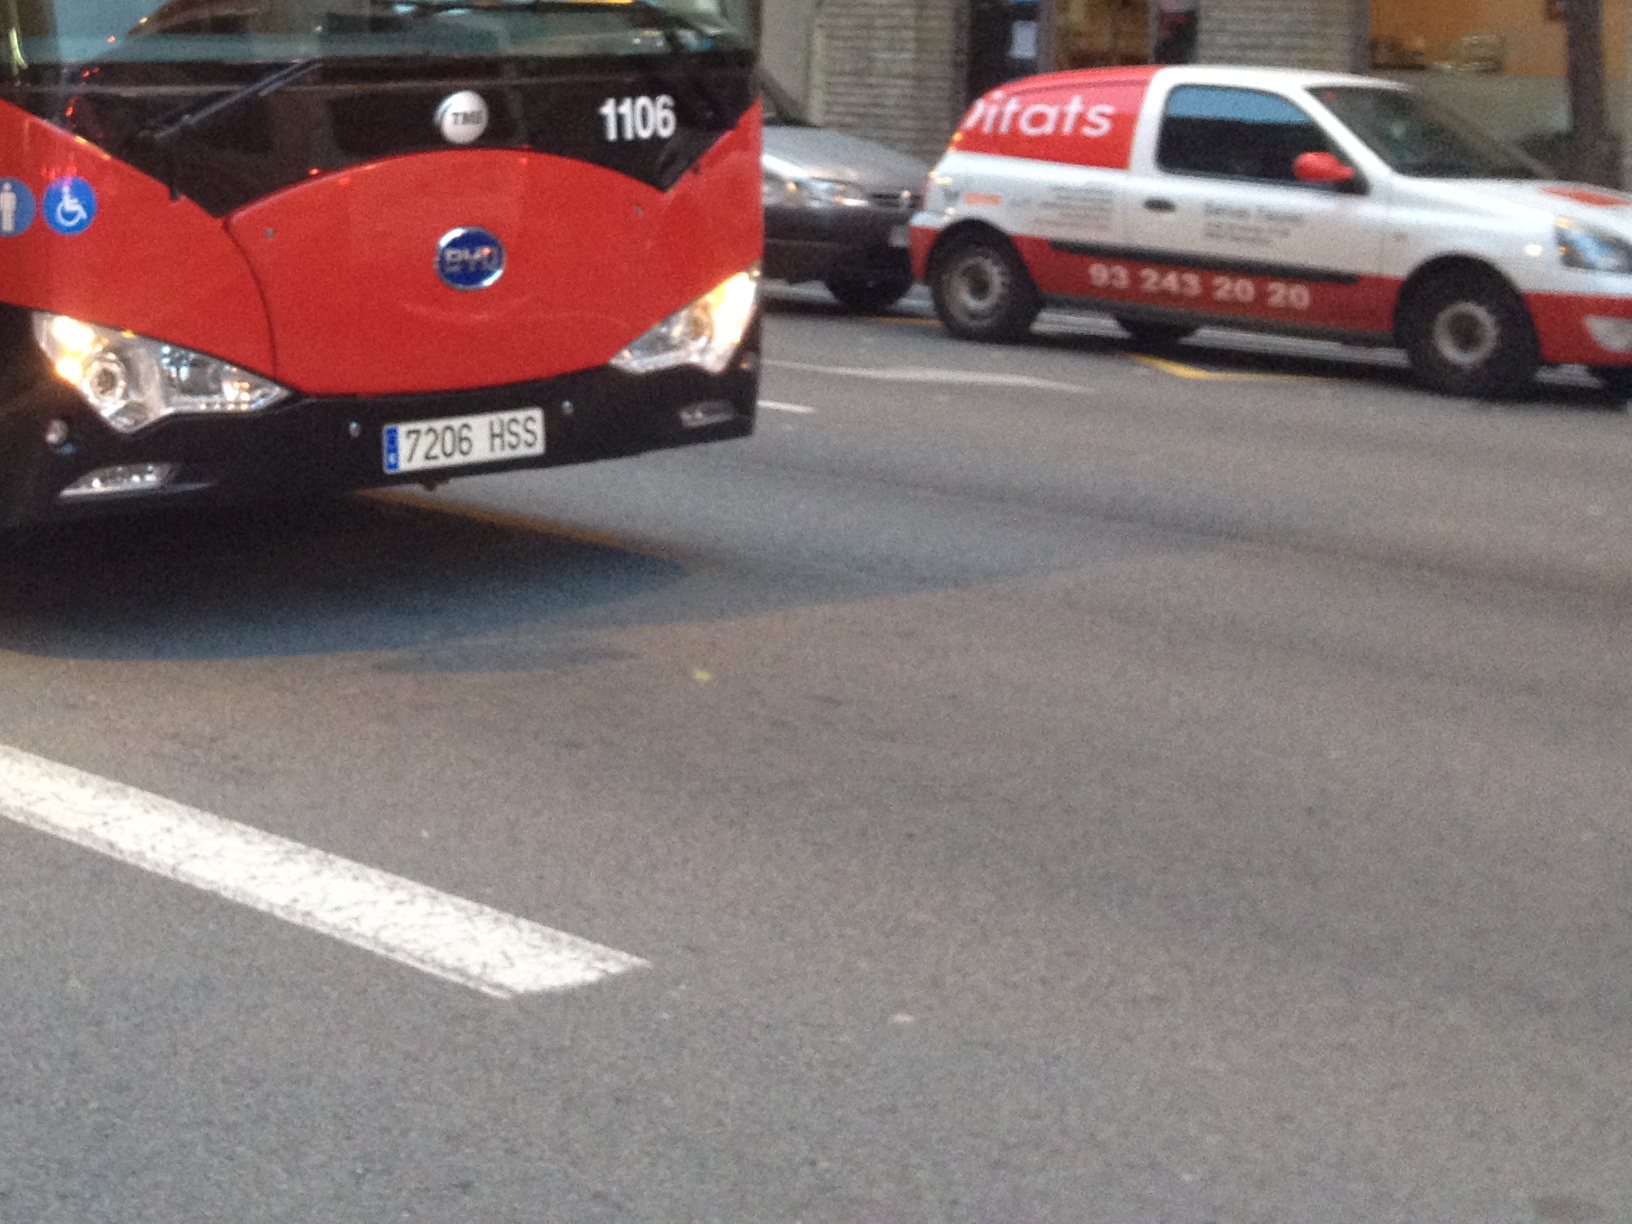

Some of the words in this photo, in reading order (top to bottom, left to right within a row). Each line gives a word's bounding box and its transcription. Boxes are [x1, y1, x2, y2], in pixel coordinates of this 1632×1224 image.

[599, 94, 676, 141] 1106
[1088, 263, 1129, 289] 93
[1139, 268, 1202, 297] 243
[1212, 275, 1256, 303] 20
[1268, 282, 1311, 310] 20
[405, 423, 473, 463] 7206
[489, 416, 538, 452] HSS
